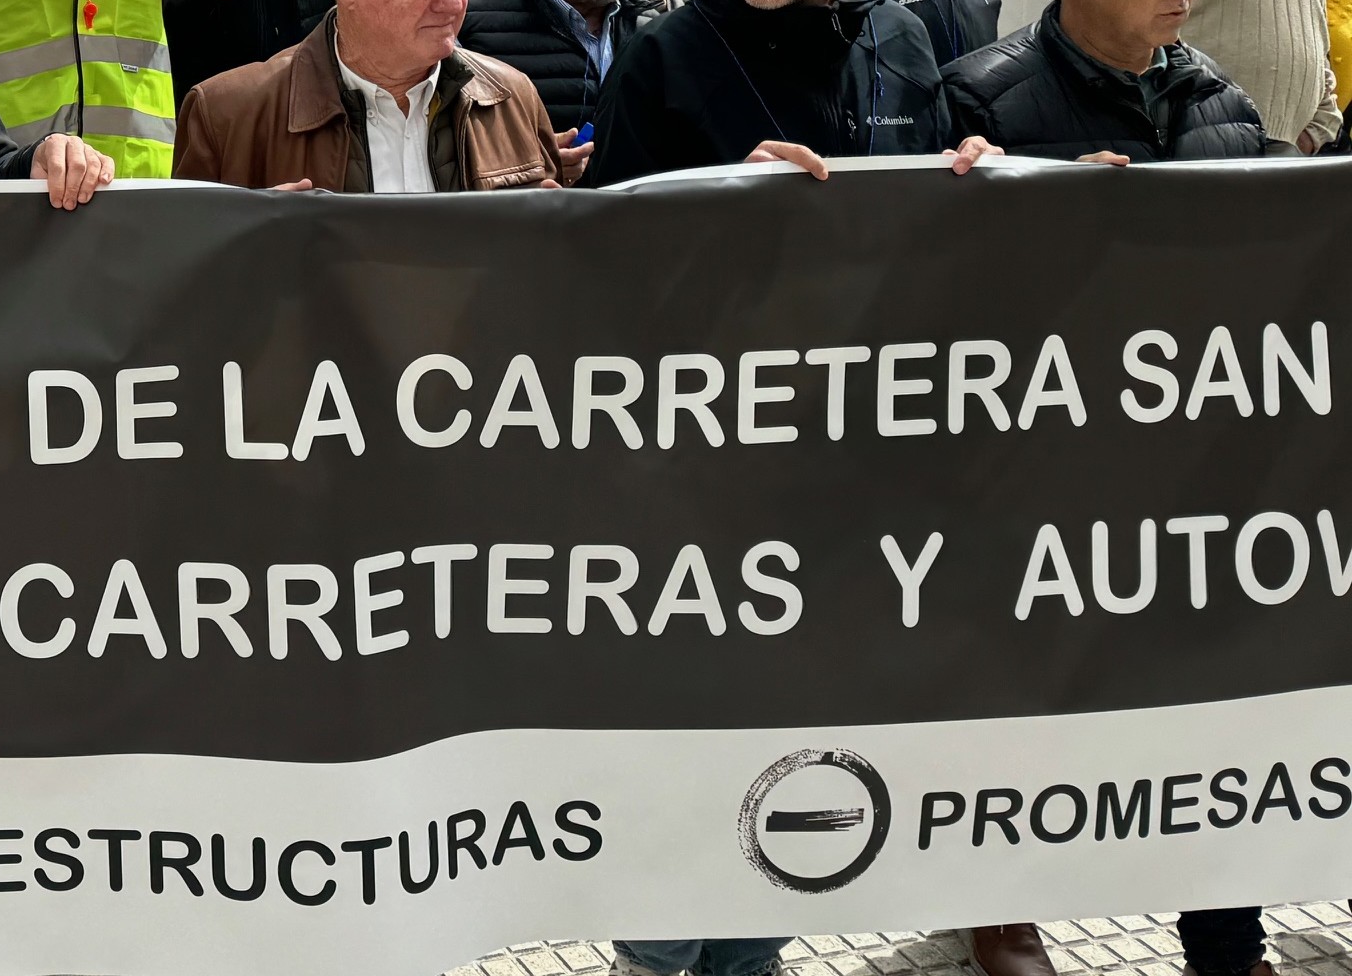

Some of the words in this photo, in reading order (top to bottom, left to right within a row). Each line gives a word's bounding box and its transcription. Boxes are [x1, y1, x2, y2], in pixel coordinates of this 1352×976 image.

[874, 115, 914, 125] Columbia
[27, 365, 184, 465] DE
[222, 359, 366, 462] LA
[396, 334, 1087, 450] CARRETERA
[1120, 320, 1332, 424] SAN
[0, 540, 803, 662] CARRETERAS
[880, 531, 944, 628] Y
[918, 757, 1352, 851] PROMESAS
